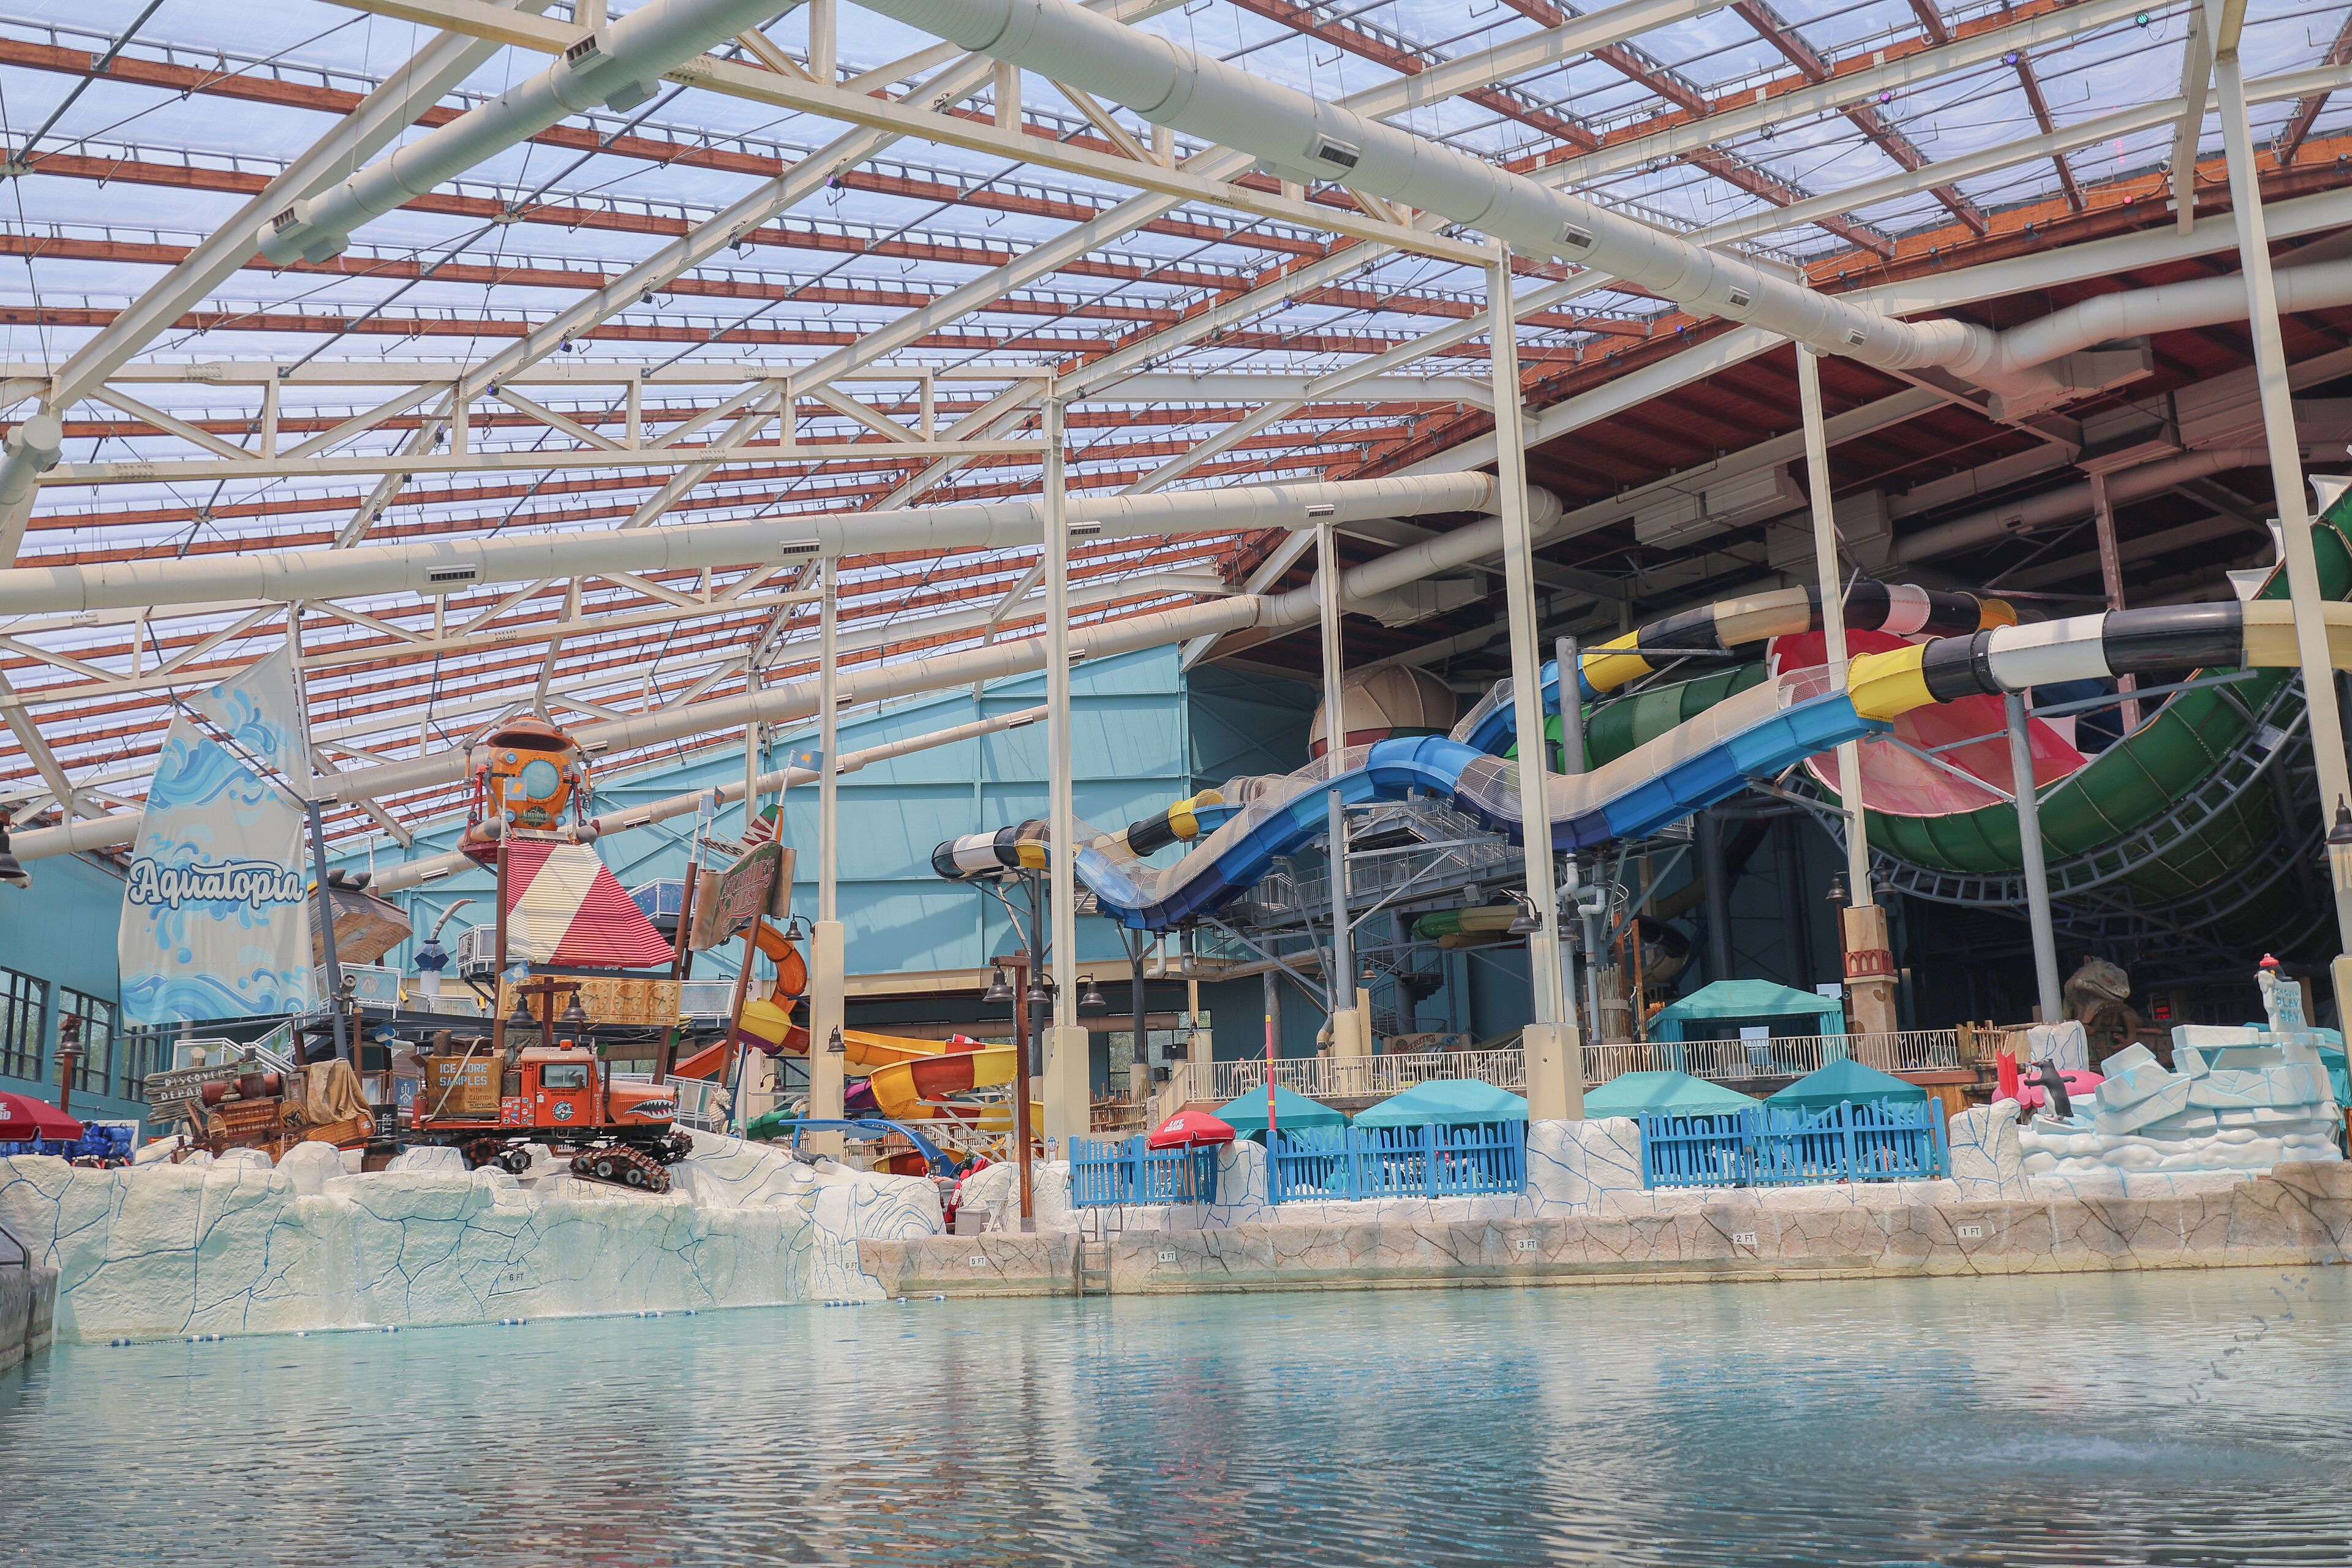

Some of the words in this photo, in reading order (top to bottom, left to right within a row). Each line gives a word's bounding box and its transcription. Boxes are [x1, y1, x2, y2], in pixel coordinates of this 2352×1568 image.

[128, 856, 305, 910] Aquatopia
[2276, 997, 2299, 1009] PLAY
[2280, 1009, 2300, 1023] BAY
[439, 1063, 457, 1074] ICE
[524, 1063, 534, 1072] 15
[439, 1076, 488, 1086] SAMPLES
[1169, 1118, 1185, 1126] LIFE
[1163, 1123, 1184, 1133] GUARD
